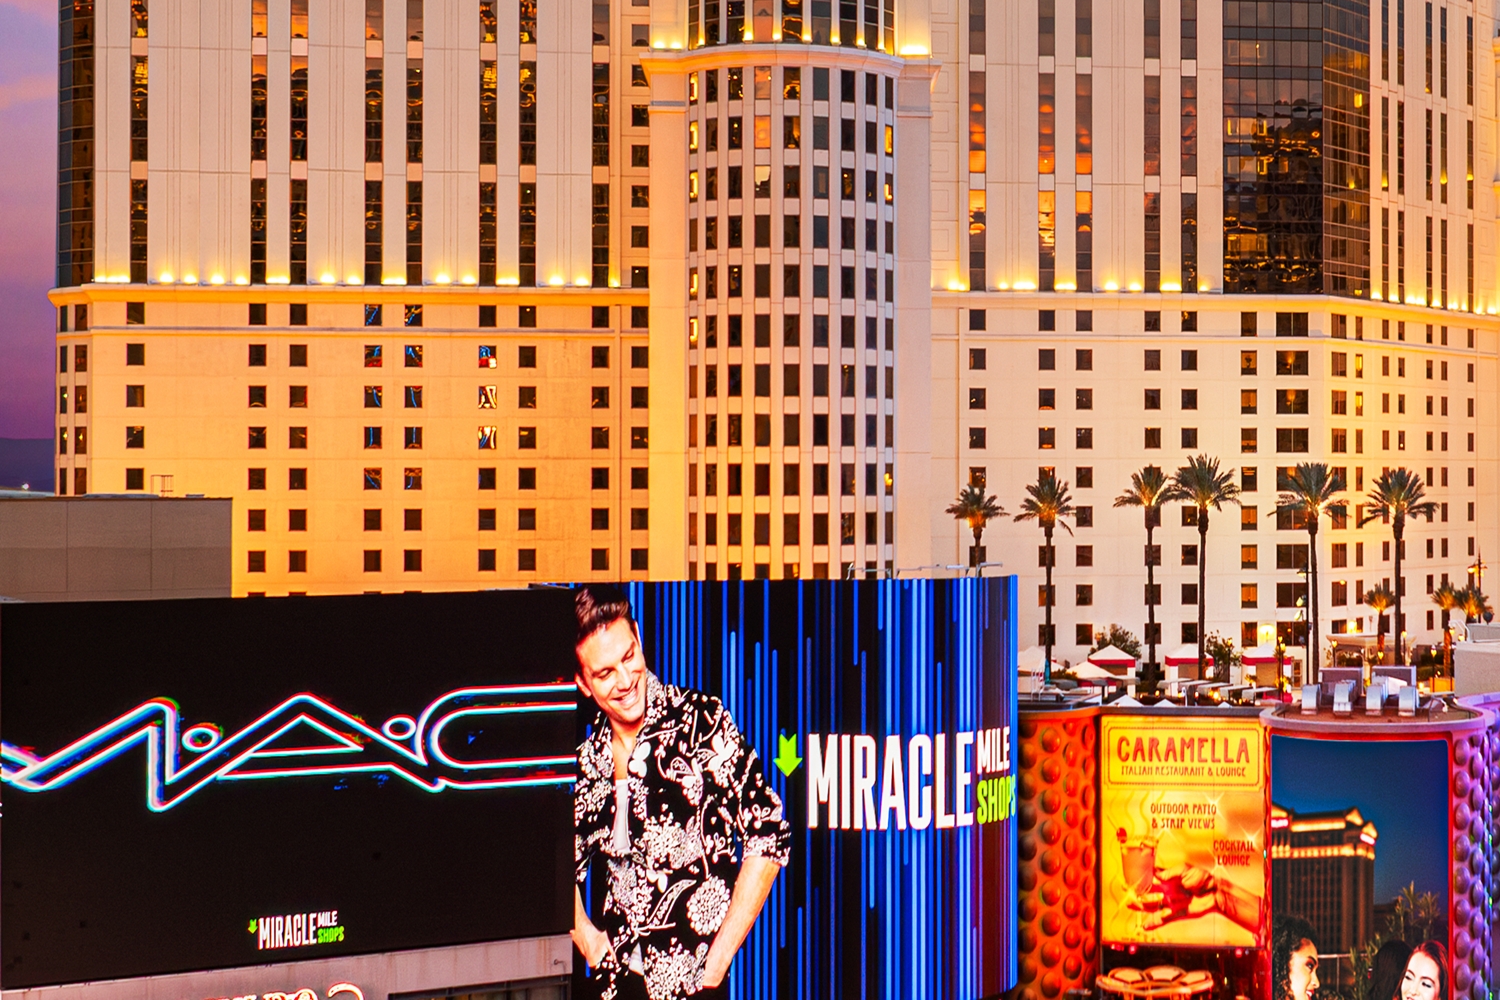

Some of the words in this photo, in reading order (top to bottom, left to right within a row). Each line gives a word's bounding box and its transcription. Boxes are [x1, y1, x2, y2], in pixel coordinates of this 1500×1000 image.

[1117, 736, 1250, 763] CARAMELLA
[806, 731, 974, 830] MIRACLE
[977, 726, 1010, 774] MILE
[1121, 766, 1152, 776] ITALIAN
[1155, 766, 1204, 776] RESTAURANT
[1207, 767, 1213, 776] &
[1216, 767, 1246, 777] LOUNGE
[977, 774, 1016, 824] SHOPS
[1150, 803, 1190, 815] OUTDOOR
[1192, 804, 1217, 815] PATIO
[1151, 818, 1158, 829] &
[1161, 818, 1185, 829] STRIP
[1188, 818, 1215, 829] VIEWS
[1213, 840, 1255, 852] COCKTAIL
[1217, 855, 1250, 866] LOUNGE
[258, 913, 317, 950] MIRACLE
[318, 911, 338, 928] MILE
[317, 926, 345, 944] SHOPS
